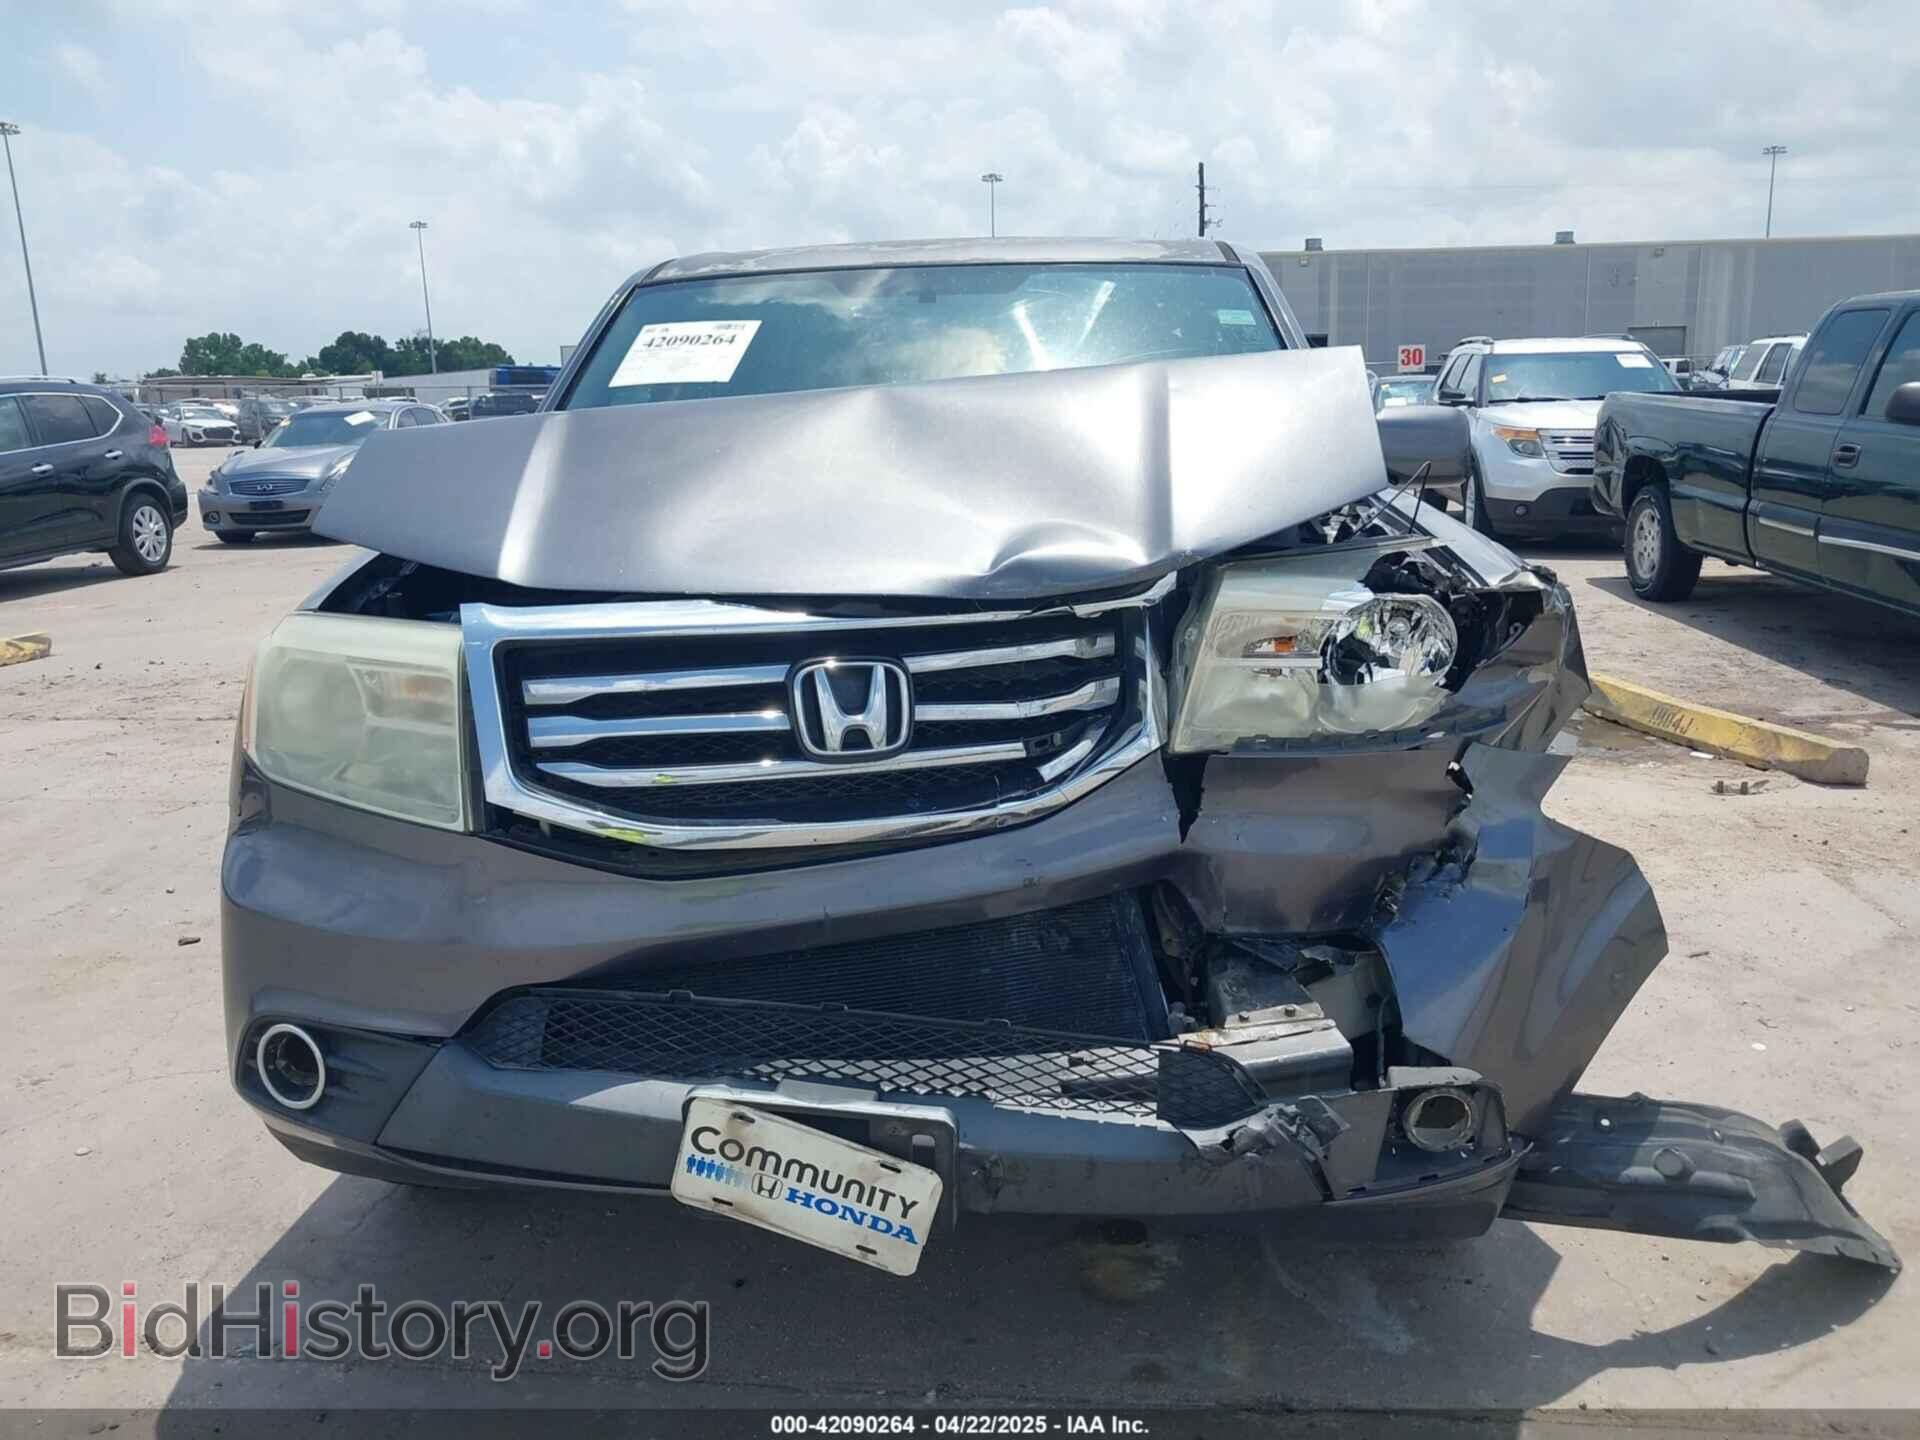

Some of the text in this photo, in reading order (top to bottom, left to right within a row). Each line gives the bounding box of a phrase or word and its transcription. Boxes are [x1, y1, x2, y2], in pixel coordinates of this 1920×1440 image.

[643, 334, 736, 348] 42090264
[1401, 348, 1424, 366] 30
[785, 1186, 918, 1245] HONDA
